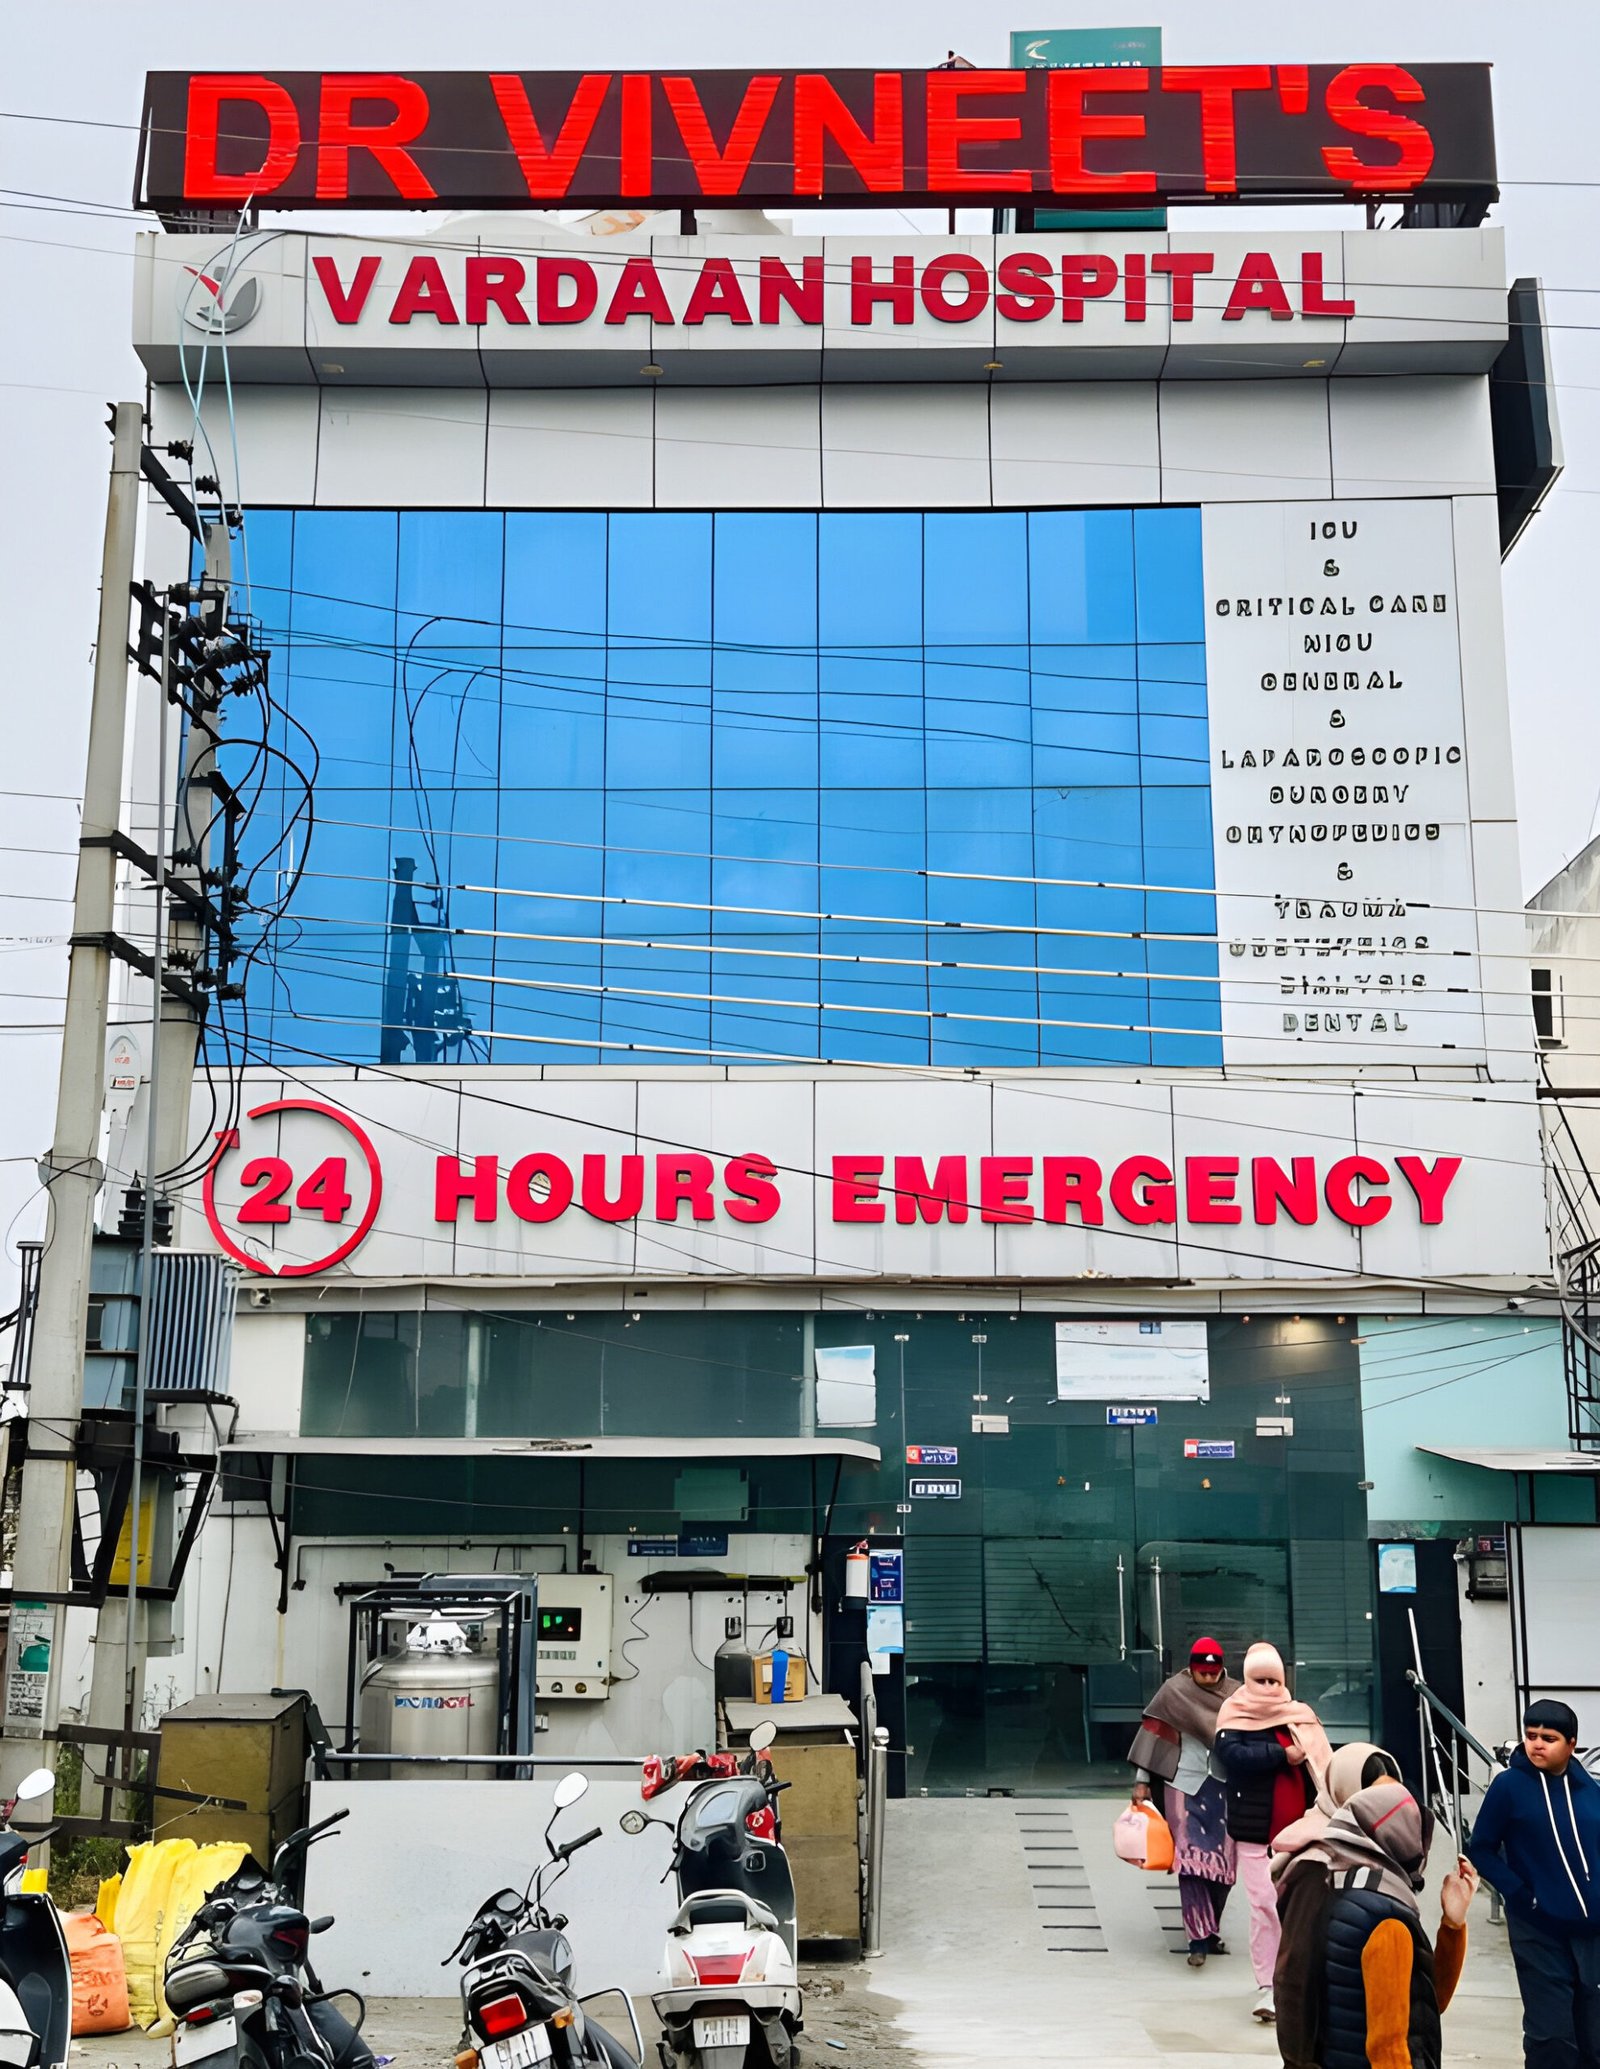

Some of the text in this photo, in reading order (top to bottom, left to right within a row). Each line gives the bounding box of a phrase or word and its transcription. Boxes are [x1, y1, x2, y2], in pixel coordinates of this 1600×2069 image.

[183, 63, 1435, 200] DR VIVNEET'S
[312, 252, 1356, 325] VARDAAN HOSPITAL
[1283, 1012, 1409, 1033] DENTAL
[236, 1152, 1464, 1227] 24 HOURS EMERGENCY
